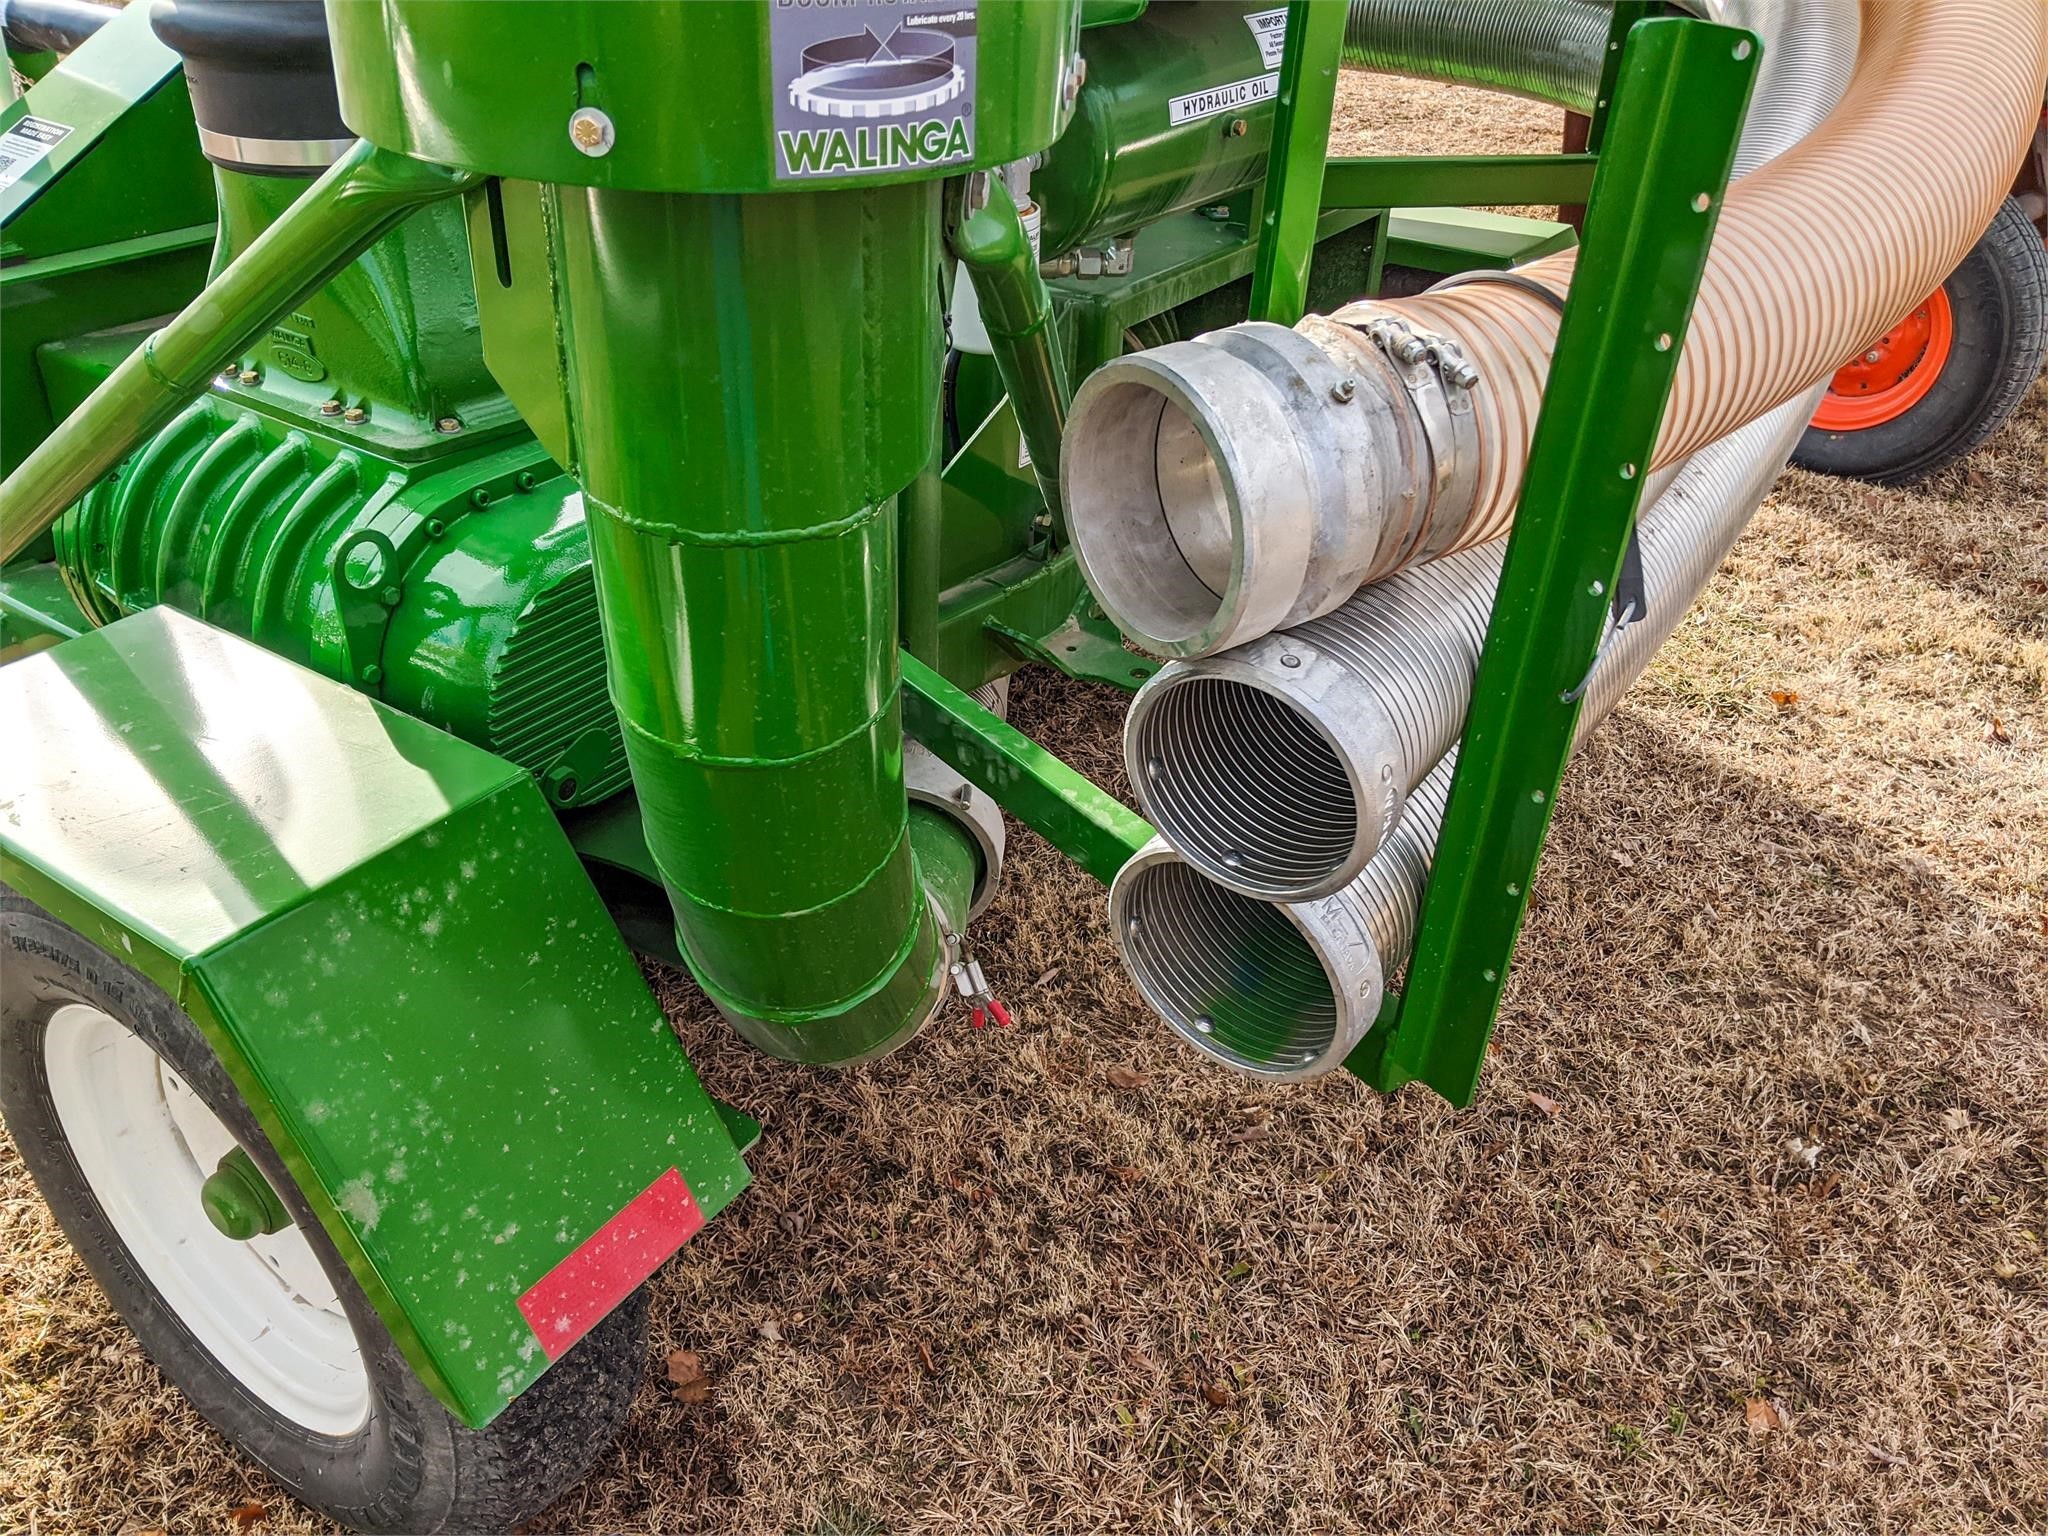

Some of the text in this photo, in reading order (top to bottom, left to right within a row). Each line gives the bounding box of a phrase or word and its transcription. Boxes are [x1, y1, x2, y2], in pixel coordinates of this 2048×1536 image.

[1183, 81, 1269, 116] HYDRAULIC OIL
[778, 117, 971, 174] WALINGA
